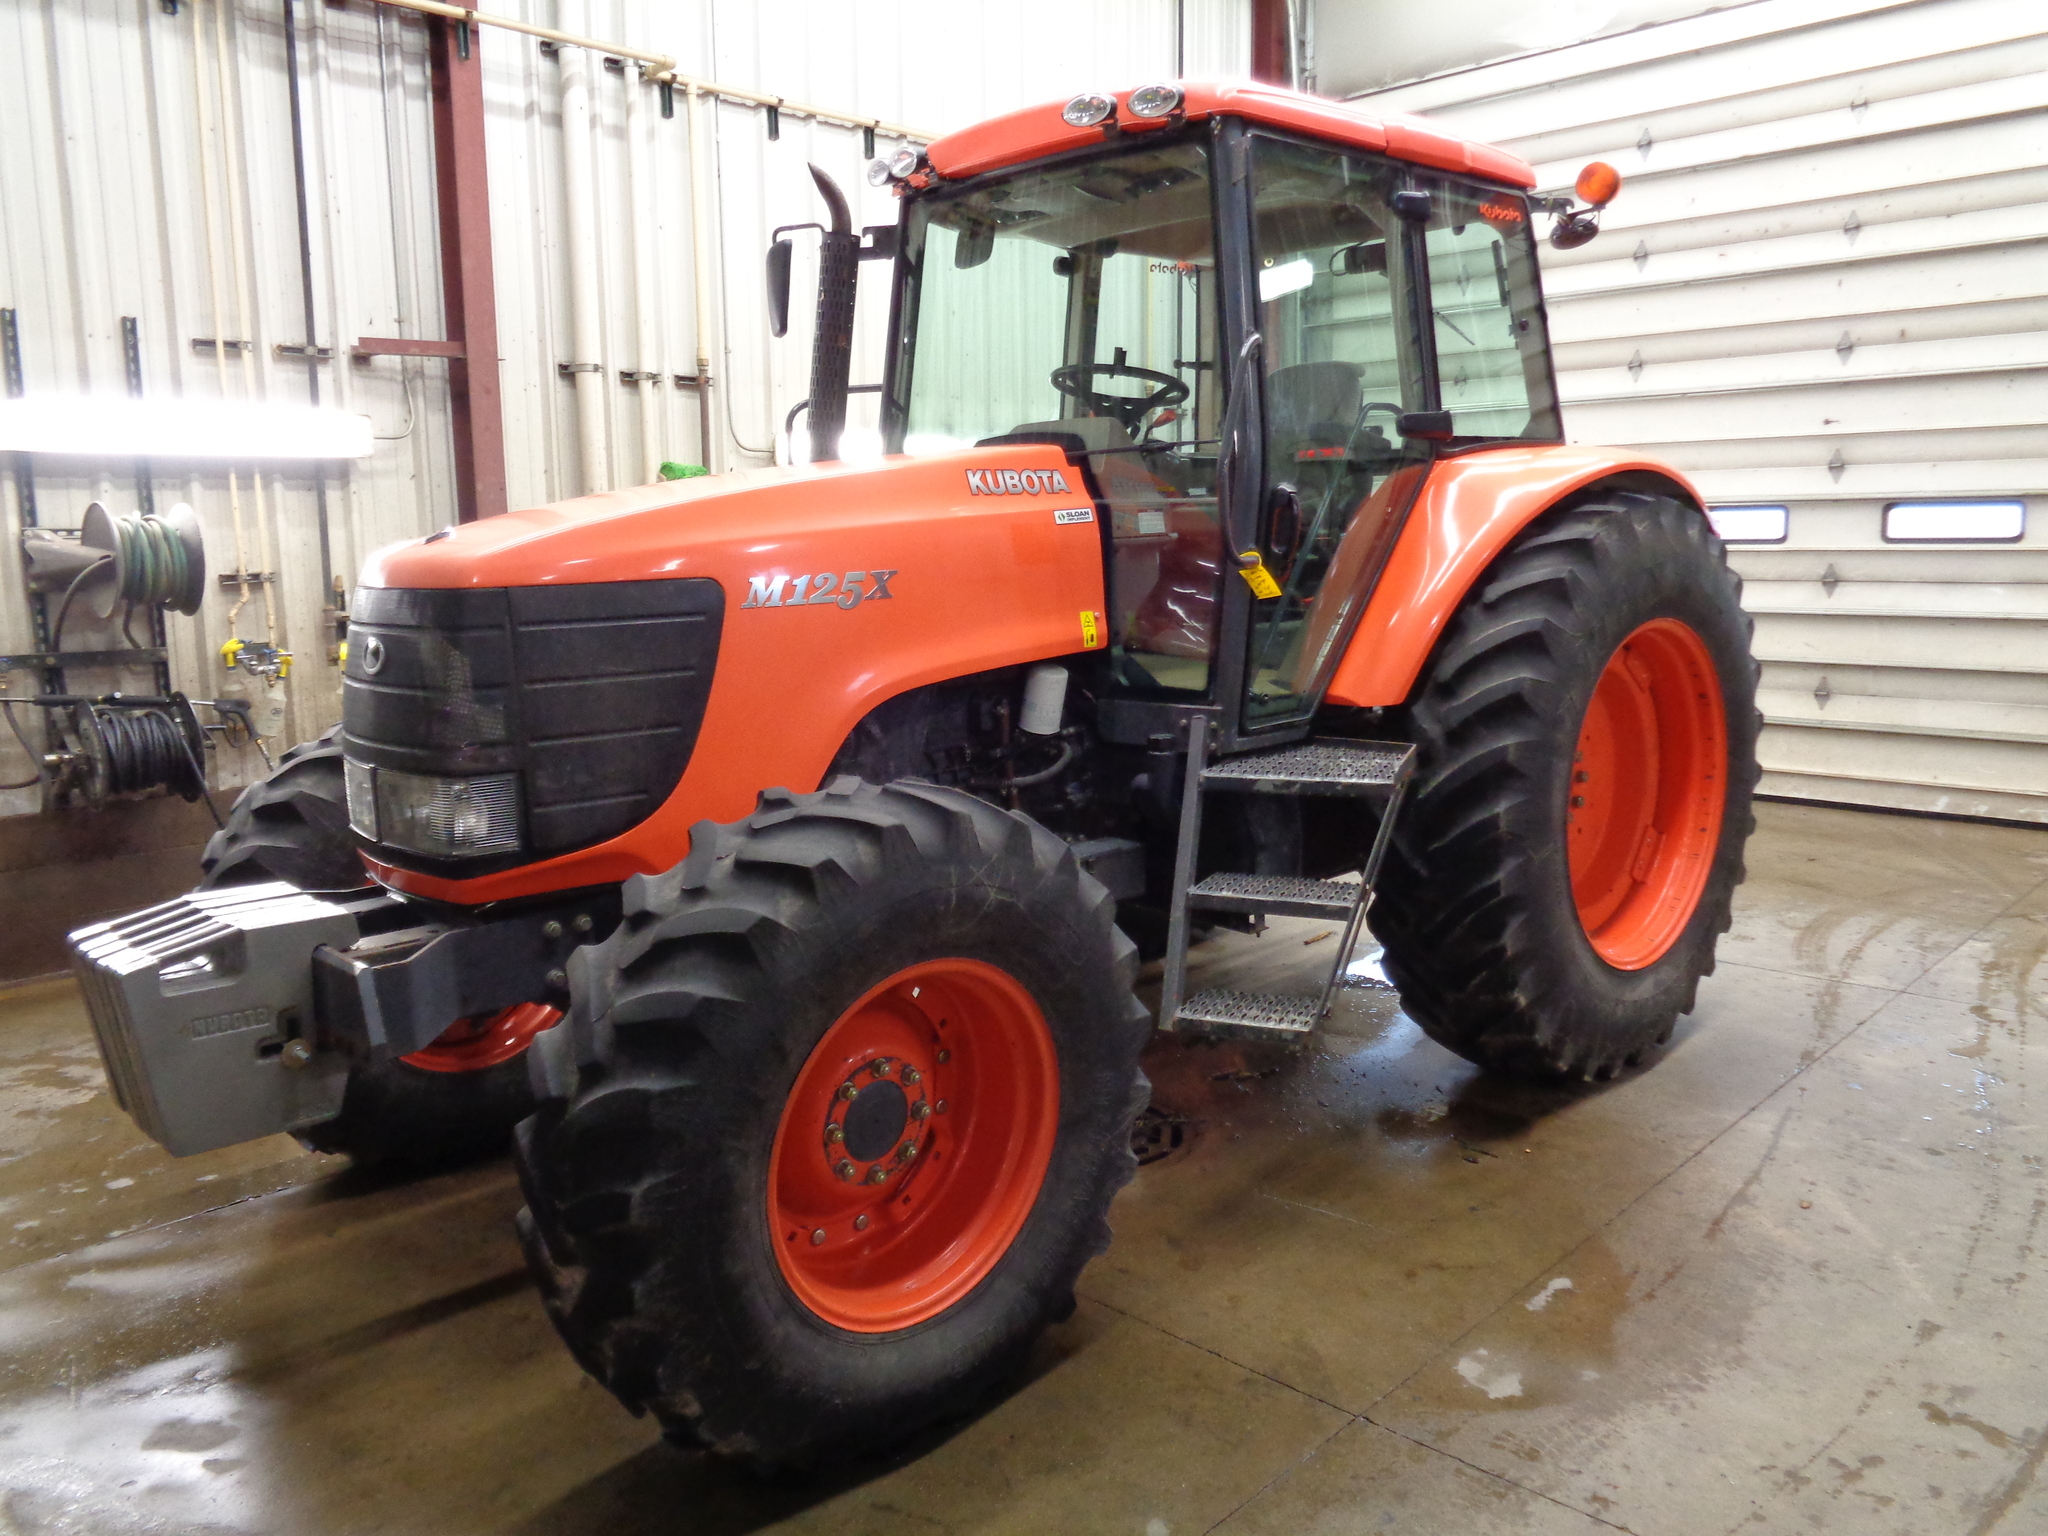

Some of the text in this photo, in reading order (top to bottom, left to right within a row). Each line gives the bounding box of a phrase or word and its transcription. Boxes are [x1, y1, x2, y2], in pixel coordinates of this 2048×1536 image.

[1478, 203, 1523, 223] Kubota
[965, 468, 1072, 496] KUBOTA
[1065, 509, 1090, 518] SLOAN
[740, 569, 898, 610] M125X
